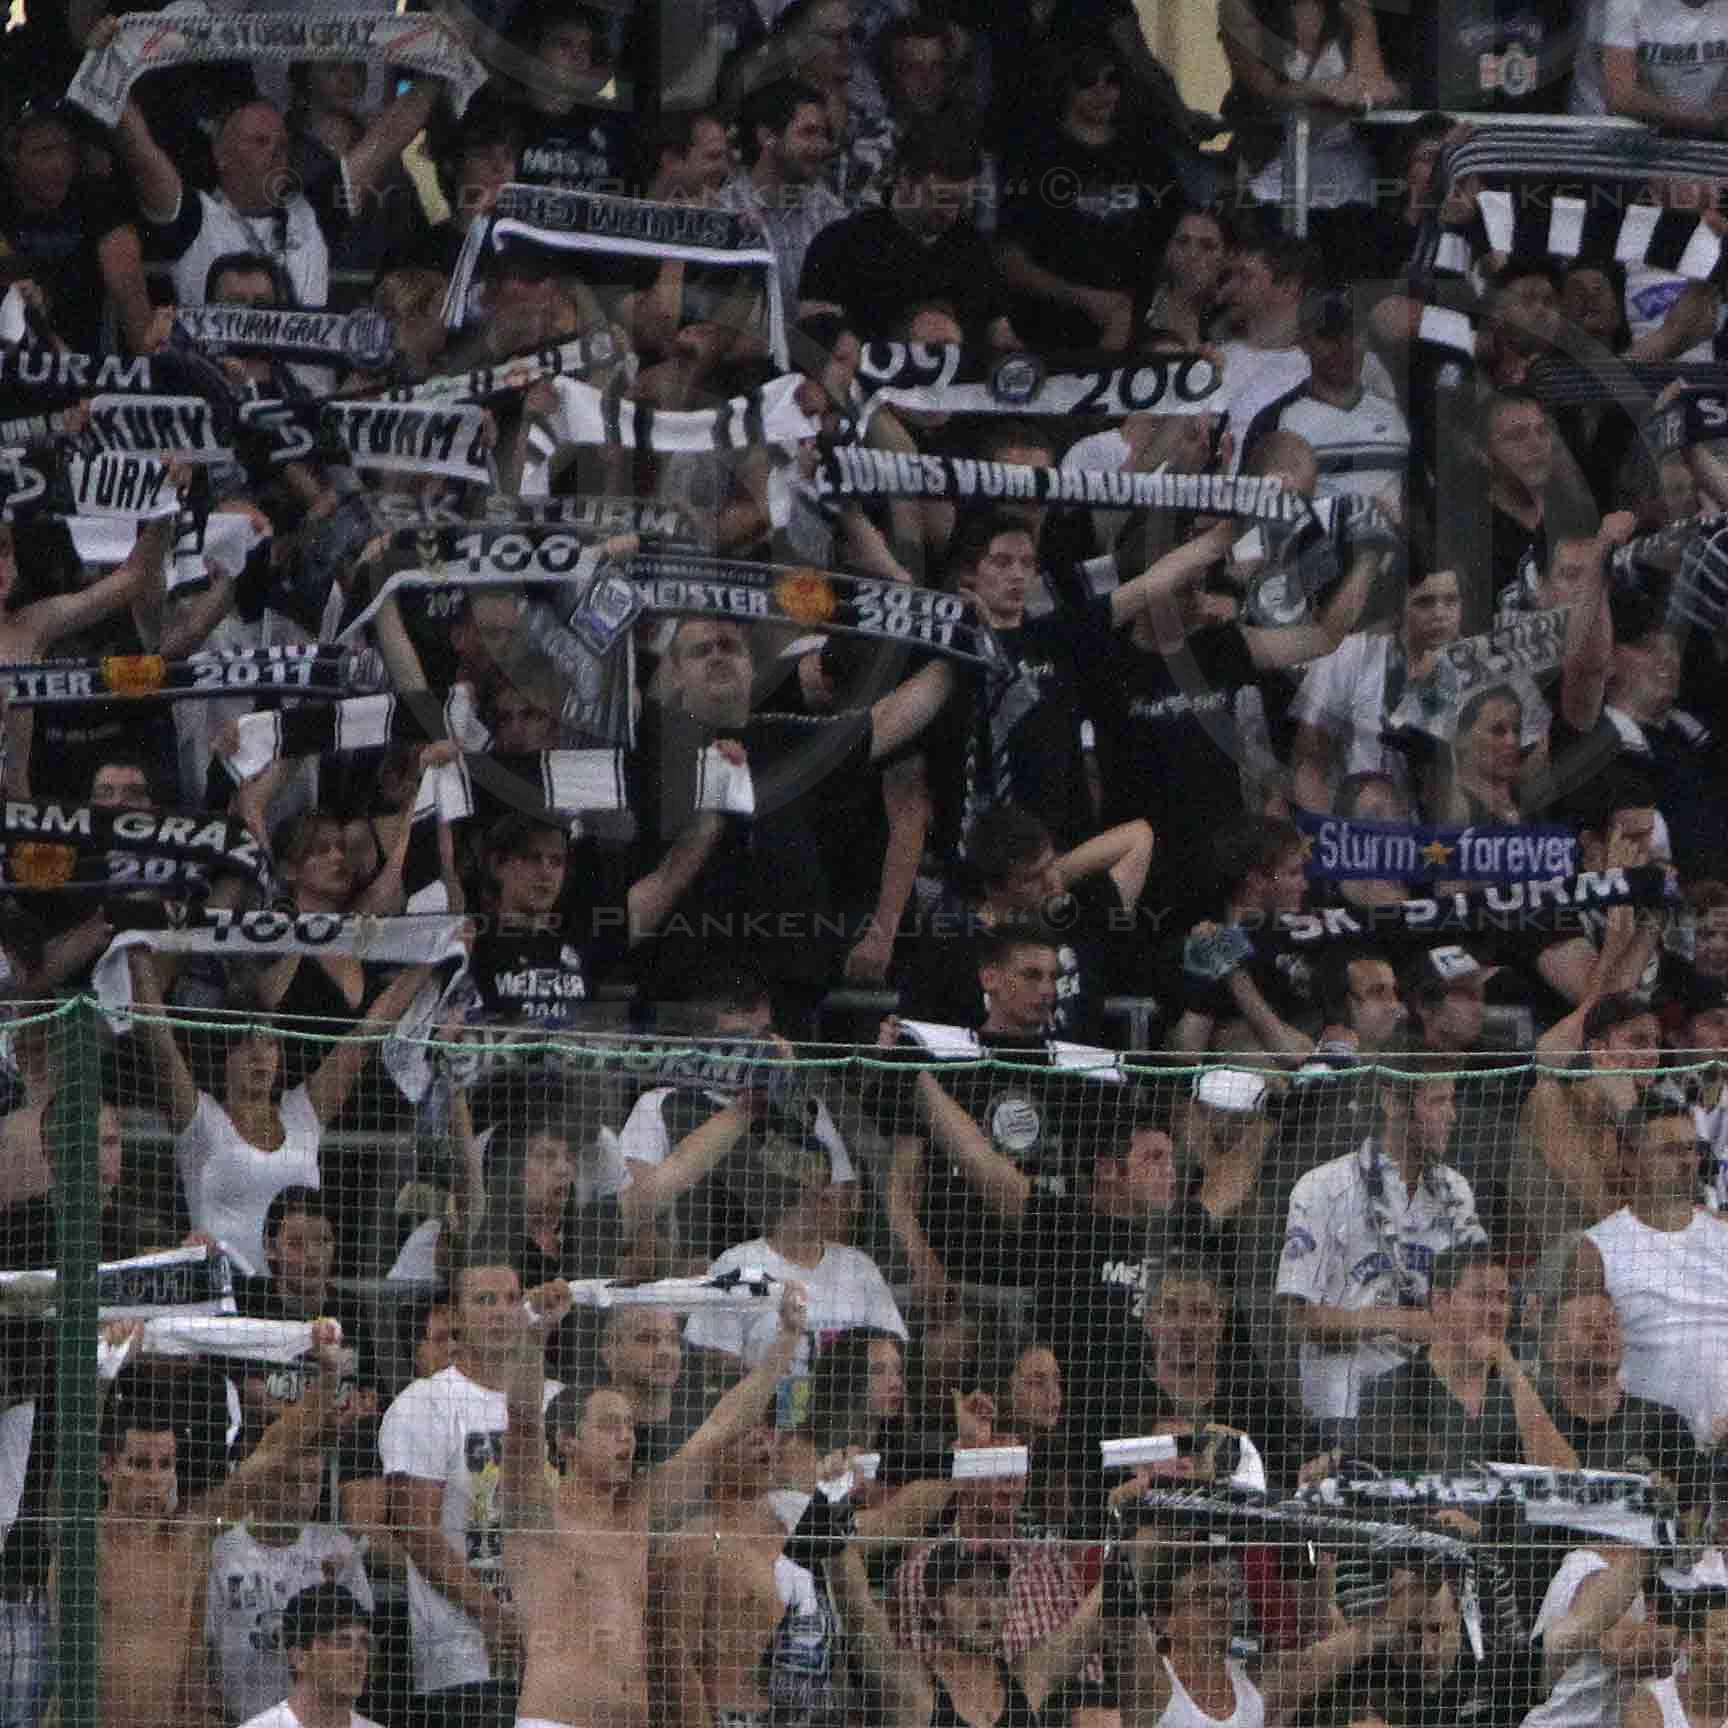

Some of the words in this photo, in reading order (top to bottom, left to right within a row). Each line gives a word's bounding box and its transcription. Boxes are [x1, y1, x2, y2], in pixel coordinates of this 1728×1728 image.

[455, 533, 580, 574] 100
[196, 661, 314, 690] 2011
[112, 806, 268, 866] GRAZ
[1317, 820, 1420, 870] Sturm
[1456, 827, 1575, 874] forever
[203, 908, 342, 946] 100
[1283, 910, 1362, 944] SK
[1403, 868, 1634, 926] STURM
